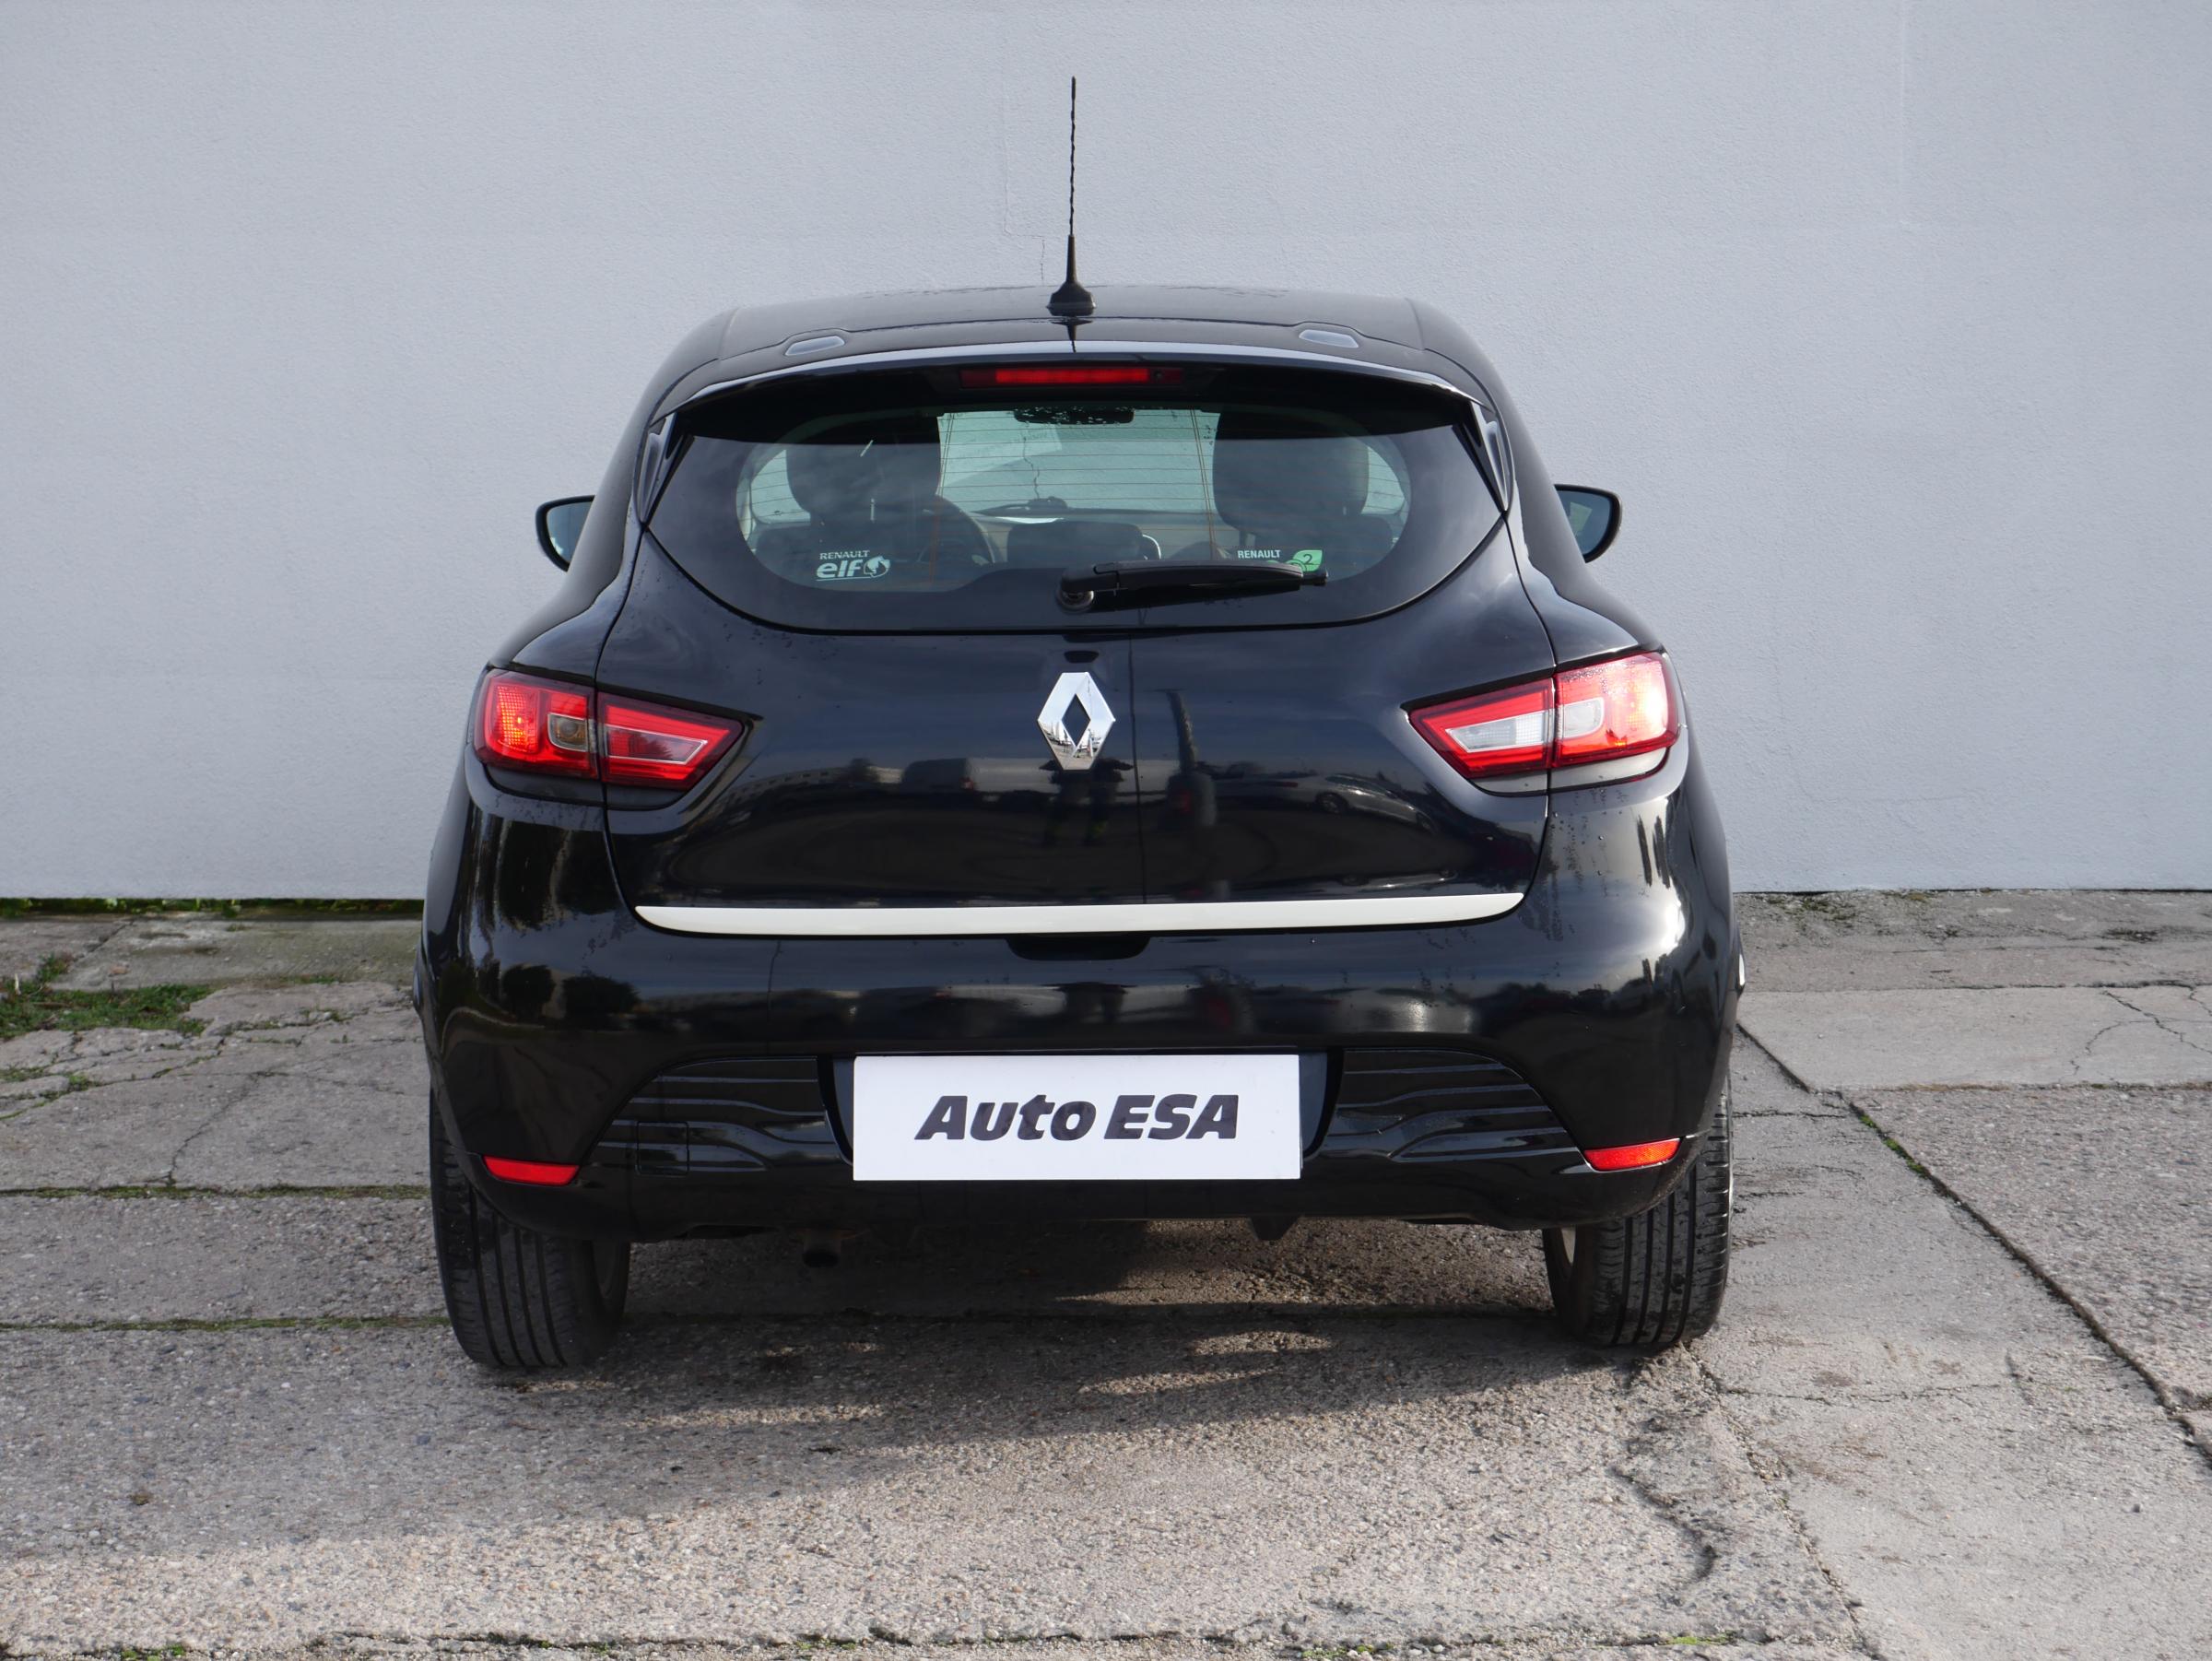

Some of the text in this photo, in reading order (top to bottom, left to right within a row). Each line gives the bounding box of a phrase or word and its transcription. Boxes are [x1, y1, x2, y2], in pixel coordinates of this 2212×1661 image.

[819, 549, 870, 560] RENAULT
[1237, 549, 1281, 560] RENAULT
[816, 559, 864, 579] elf
[913, 1093, 1240, 1141] Auto ESA
